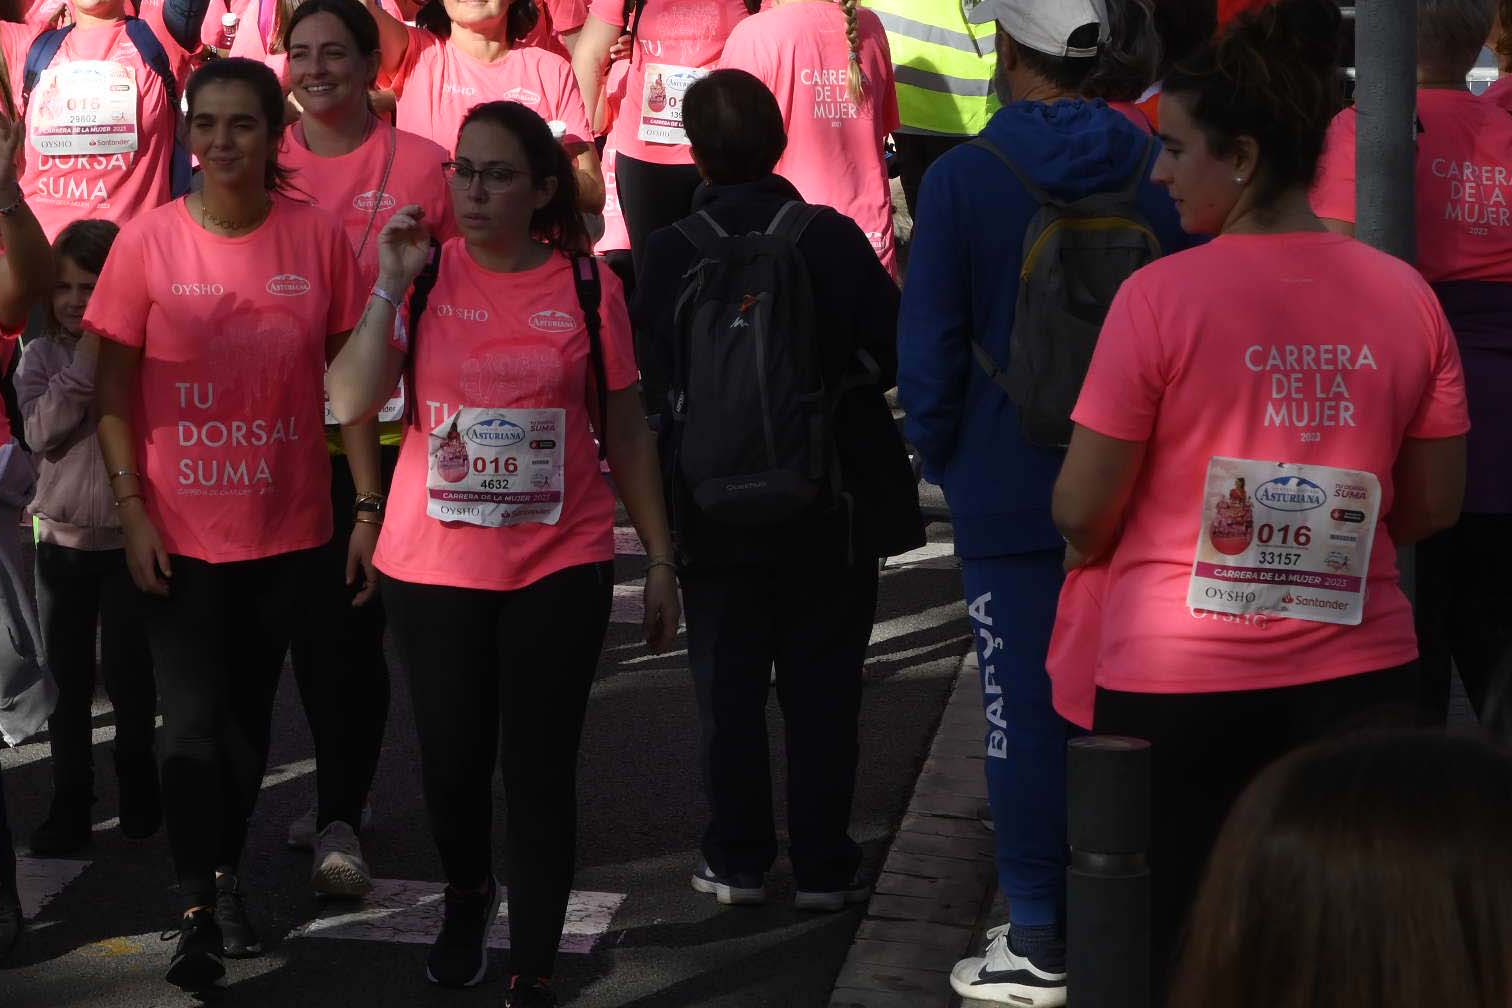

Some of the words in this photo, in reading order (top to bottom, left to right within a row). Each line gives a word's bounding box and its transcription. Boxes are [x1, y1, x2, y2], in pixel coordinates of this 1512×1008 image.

[815, 85, 831, 101] DE
[836, 86, 850, 101] LA
[813, 102, 857, 119] MUJER
[37, 177, 108, 200] SUMA
[1450, 179, 1476, 203] DE
[1444, 202, 1510, 227] MUJER
[171, 283, 224, 296] OYSHO
[437, 303, 488, 323] OYSHO
[1244, 344, 1378, 372] CARRERA
[1271, 373, 1304, 398] DE
[1316, 372, 1349, 398] LA
[175, 383, 214, 409] TU
[1264, 401, 1356, 427] MUJER
[178, 416, 299, 448] DORSAL
[471, 429, 522, 441] ASTURIANA
[178, 457, 273, 486] SUMA
[473, 457, 518, 474] 016
[480, 479, 509, 490] 4632
[442, 492, 479, 500] CARRERA
[1260, 489, 1320, 505] ASTURIANA
[1334, 489, 1366, 501] SUMA
[440, 505, 480, 516] OYSHO
[1256, 523, 1312, 547] 016
[1258, 551, 1302, 566] 33157
[1214, 568, 1258, 580] CARRERA
[1260, 571, 1274, 580] DE
[1275, 573, 1286, 581] LA
[1288, 573, 1322, 584] MUJER
[1325, 576, 1348, 587] 2023
[1205, 587, 1256, 603] OYSHO
[1296, 594, 1349, 610] Santander
